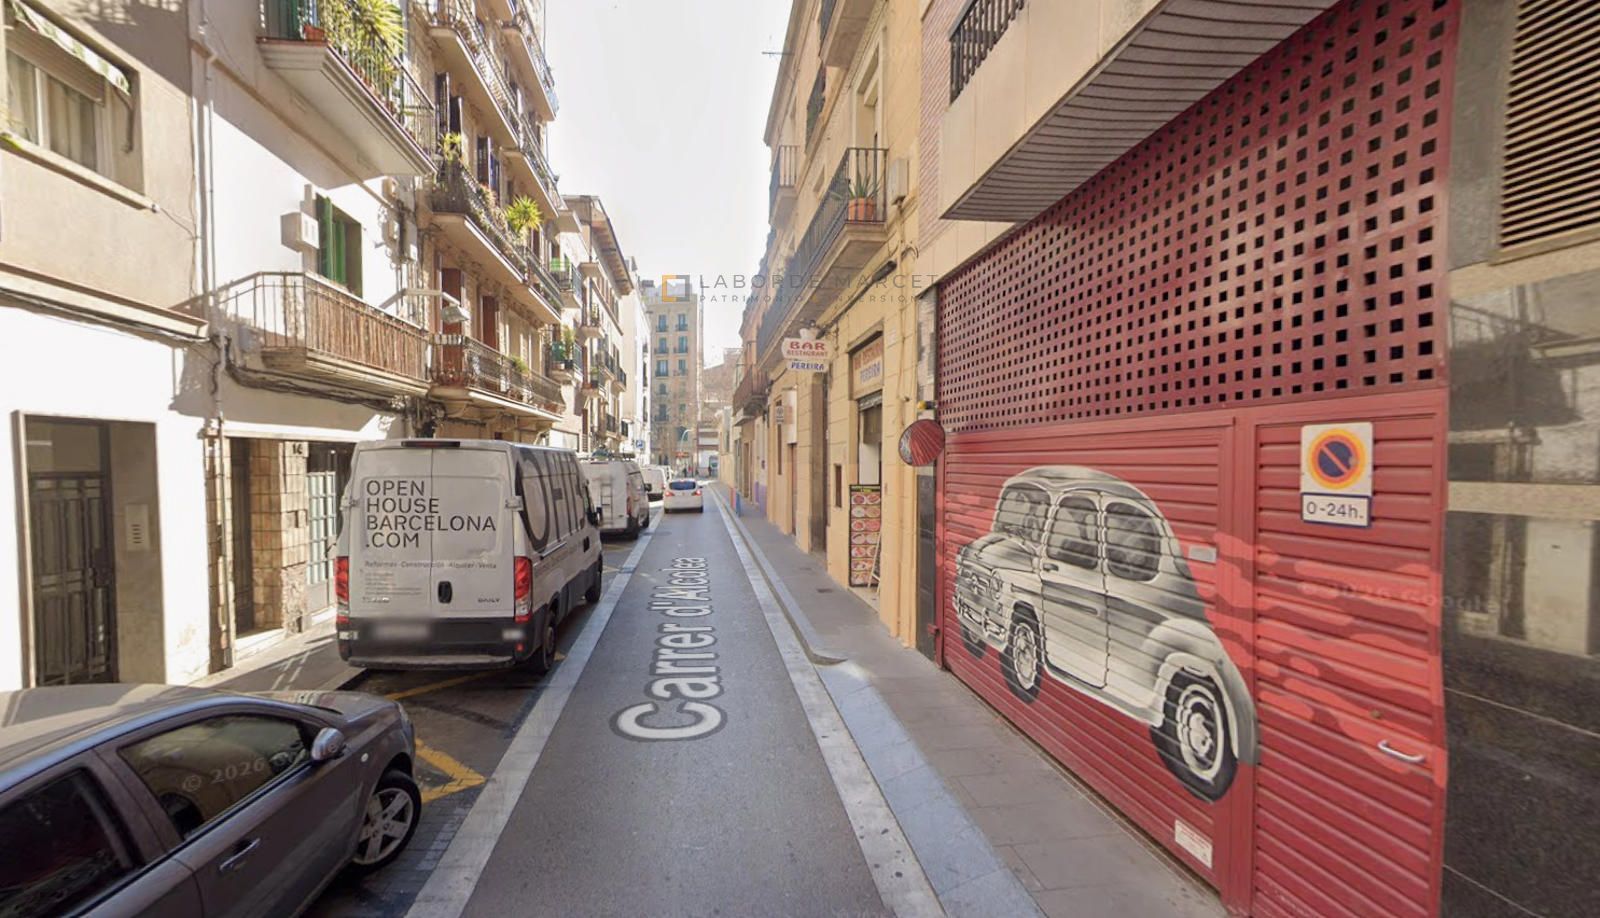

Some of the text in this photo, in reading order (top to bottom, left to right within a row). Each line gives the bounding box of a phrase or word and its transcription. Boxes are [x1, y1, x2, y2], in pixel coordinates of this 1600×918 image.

[790, 341, 825, 351] BAR
[791, 361, 824, 371] PEREIRA
[366, 480, 424, 496] OPEN
[367, 498, 439, 513] HOUSE
[367, 515, 496, 531] BARCELONA
[365, 532, 419, 548] .COM
